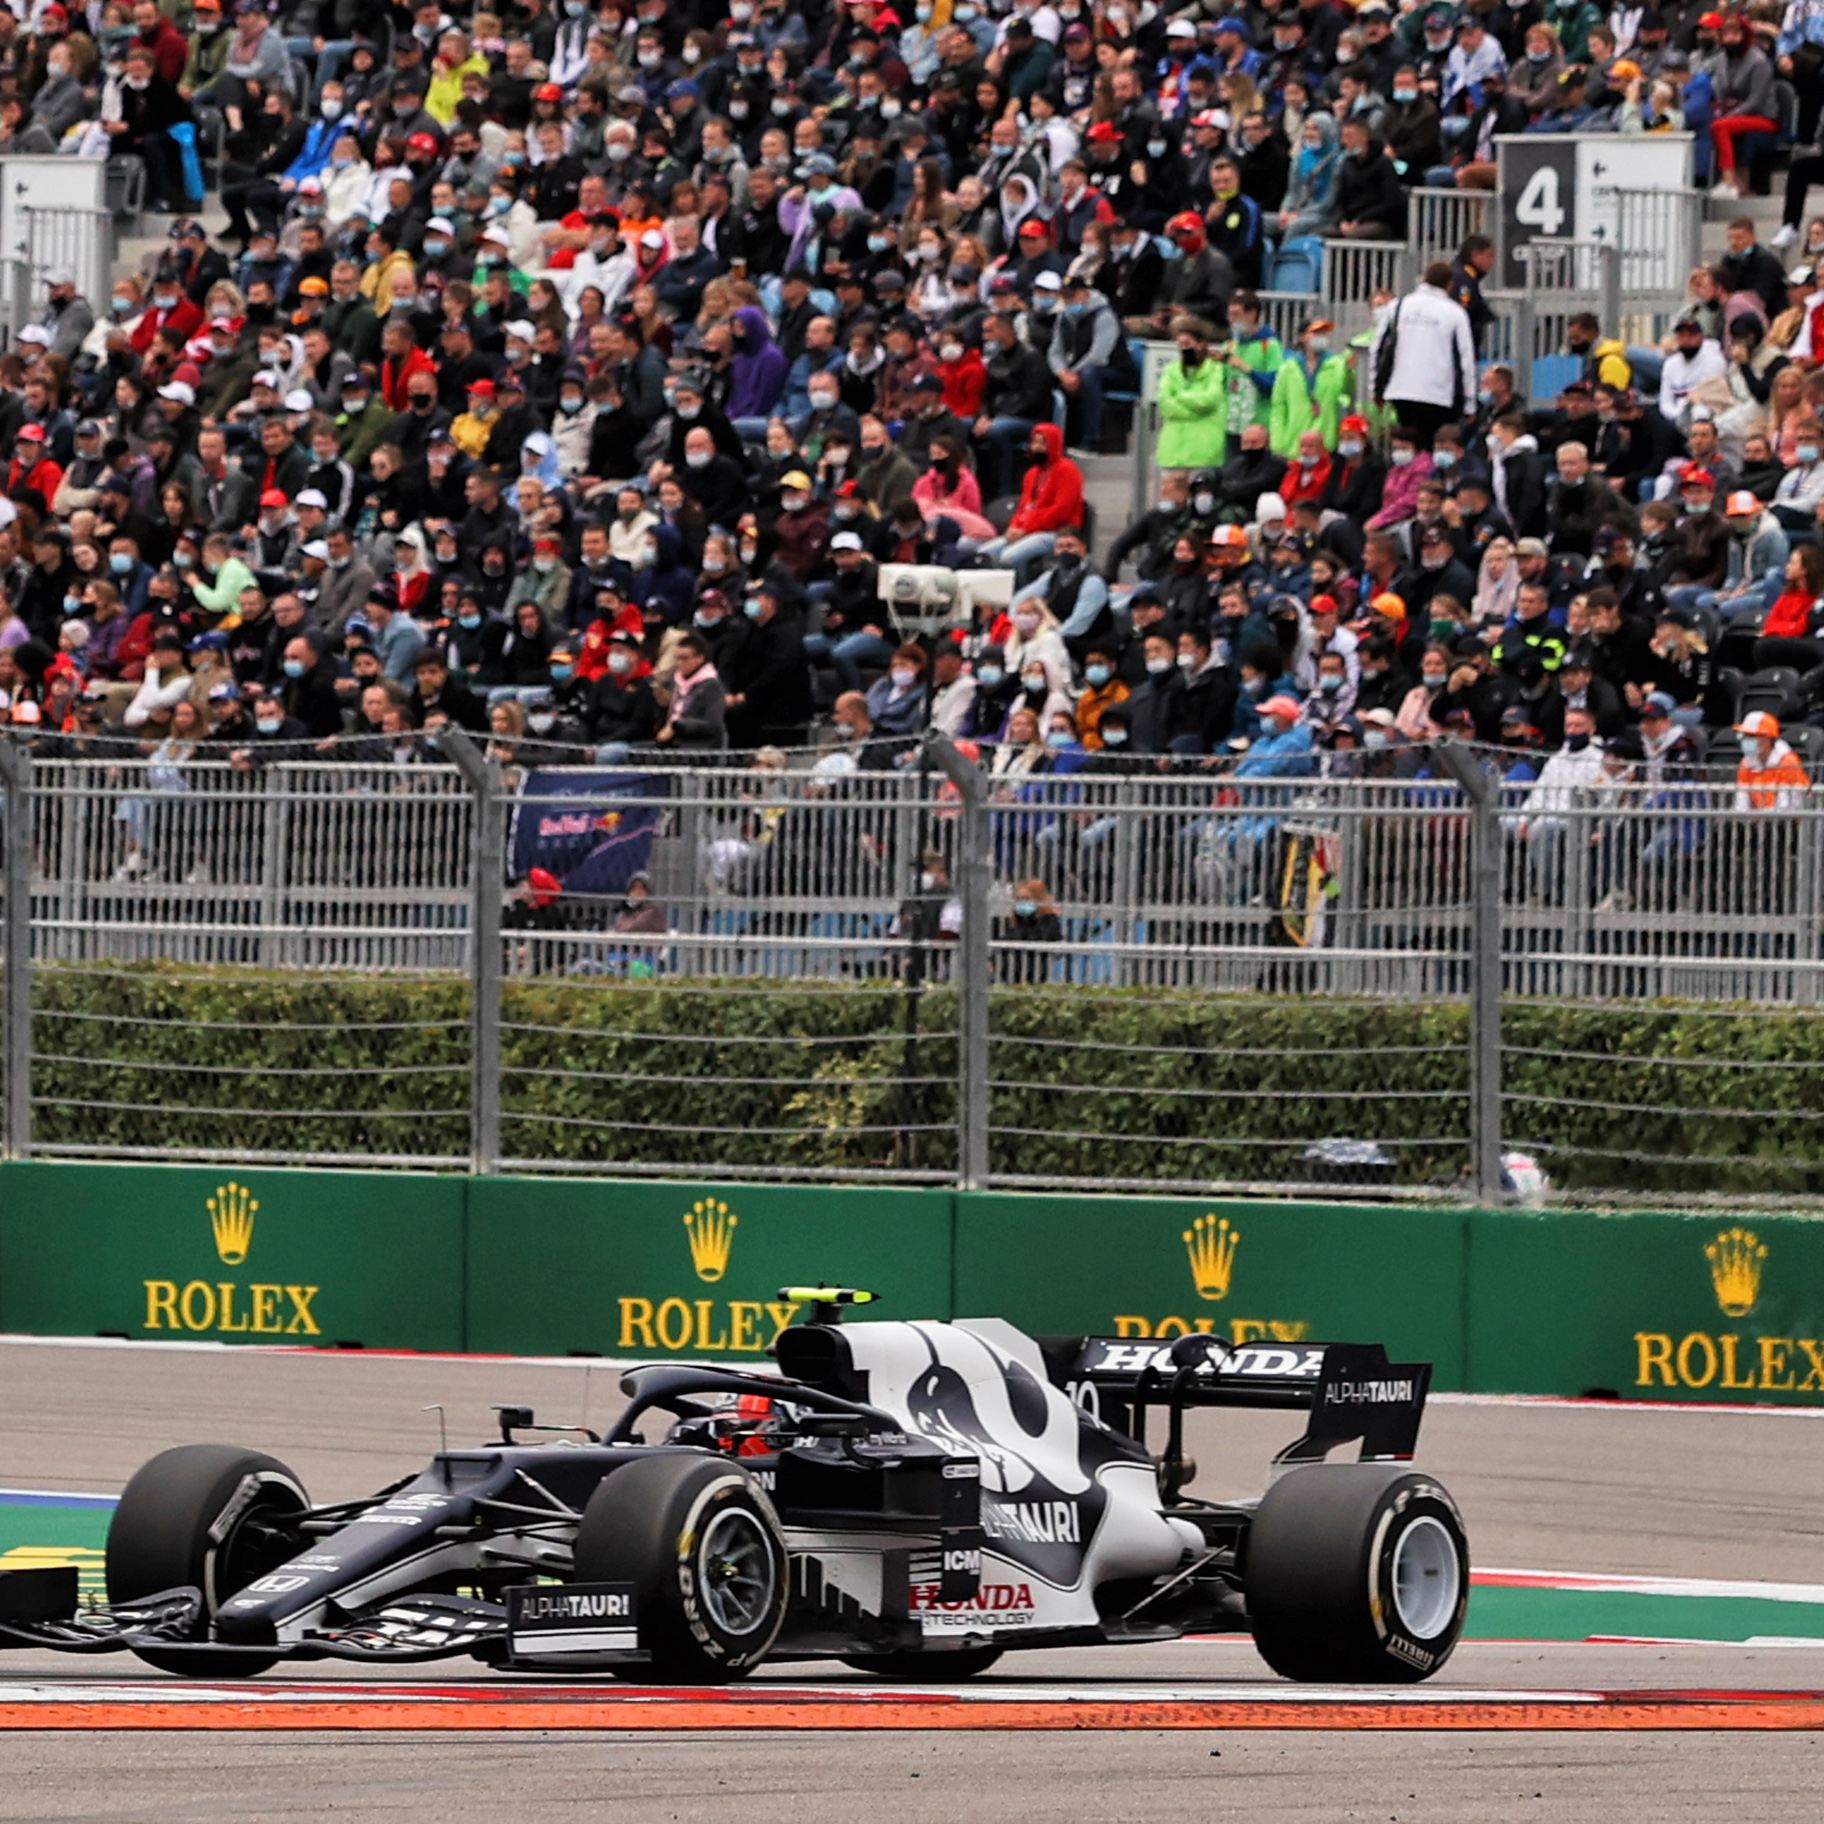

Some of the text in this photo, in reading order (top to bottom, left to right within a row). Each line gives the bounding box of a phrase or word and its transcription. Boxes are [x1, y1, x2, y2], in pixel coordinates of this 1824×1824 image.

[1515, 165, 1565, 234] 4
[144, 1280, 320, 1335] ROLEX
[617, 1297, 801, 1352] ROLEX
[1325, 1379, 1413, 1405] ALPHATAURI
[944, 1550, 980, 1570] ICM
